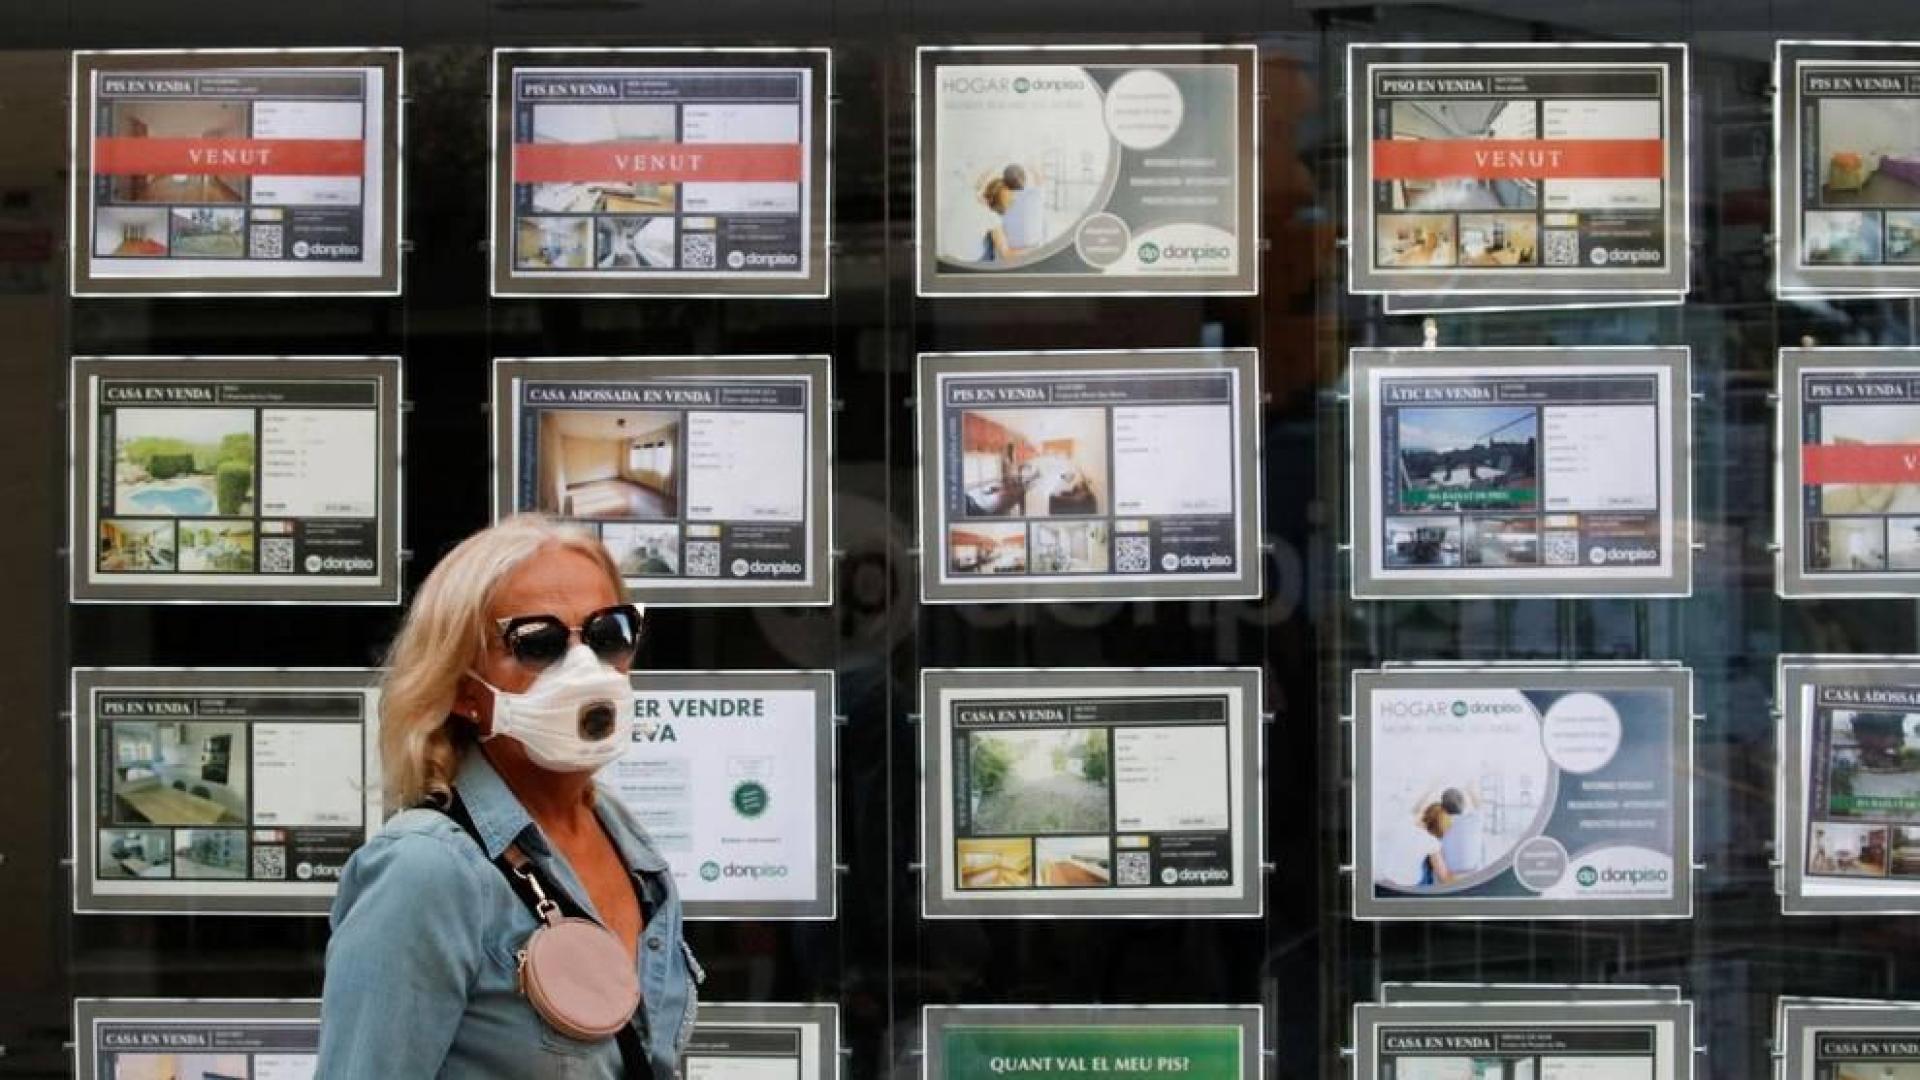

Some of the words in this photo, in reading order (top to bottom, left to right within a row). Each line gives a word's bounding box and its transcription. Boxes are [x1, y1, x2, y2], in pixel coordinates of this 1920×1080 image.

[106, 80, 125, 92] PIS
[128, 80, 145, 92] EN
[148, 80, 191, 92] VENDA
[525, 84, 546, 96] PIS
[548, 84, 567, 96] EN
[570, 84, 616, 96] VENDA
[942, 78, 1010, 94] HOGAR
[1382, 79, 1414, 92] PISO
[1416, 79, 1435, 92] EN
[1438, 79, 1484, 92] VENDA
[1810, 78, 1831, 90] PIS
[1834, 78, 1850, 90] EN
[1854, 78, 1901, 90] VENDA
[188, 149, 271, 166] VENUT
[614, 154, 703, 172] VENUT
[1474, 150, 1562, 168] VENUT
[310, 242, 360, 258] donpiso
[1163, 244, 1230, 264] donpiso
[1609, 248, 1660, 264] donpiso
[746, 252, 798, 268] donpiso
[108, 388, 142, 400] CASA
[144, 388, 164, 400] EN
[166, 388, 211, 400] VENDA
[530, 389, 565, 401] CASA
[568, 390, 640, 402] ADOSSADA
[643, 390, 662, 402] EN
[664, 390, 712, 402] VENDA
[953, 389, 974, 401] PIS
[976, 388, 996, 401] EN
[998, 388, 1045, 400] VENDA
[1424, 387, 1442, 400] EN
[1446, 387, 1490, 399] VENDA
[1812, 385, 1833, 396] PIS
[1836, 384, 1854, 396] EN
[1856, 384, 1904, 396] VENDA
[323, 555, 374, 572] donpiso
[1180, 552, 1232, 571] donpiso
[1607, 548, 1657, 564] donpiso
[750, 560, 802, 577] donpiso
[1824, 689, 1860, 701] CASA
[105, 702, 125, 713] PIS
[127, 702, 144, 713] EN
[147, 702, 190, 714] VENDA
[634, 699, 660, 717] ER
[668, 698, 765, 717] VENDRE
[1380, 702, 1447, 716] HOGAR
[961, 710, 996, 722] CASA
[998, 710, 1017, 722] EN
[1019, 709, 1064, 721] VENDA
[313, 864, 342, 879] donp
[723, 862, 788, 881] donpiso
[1179, 868, 1229, 884] donpiso
[1601, 866, 1668, 886] donpiso
[106, 1033, 139, 1045] CASA
[141, 1033, 160, 1045] EN
[162, 1033, 206, 1045] VENDA
[1388, 1036, 1421, 1048] CASA
[1424, 1036, 1444, 1048] EN
[1446, 1036, 1490, 1048] VENDA
[1824, 1042, 1859, 1054] CASA
[1861, 1042, 1880, 1054] EN
[1882, 1042, 1920, 1054] VEND
[990, 1056, 1052, 1073] QUANT
[1056, 1056, 1088, 1071] VAL
[1092, 1056, 1109, 1071] EL
[1114, 1056, 1152, 1071] MEU
